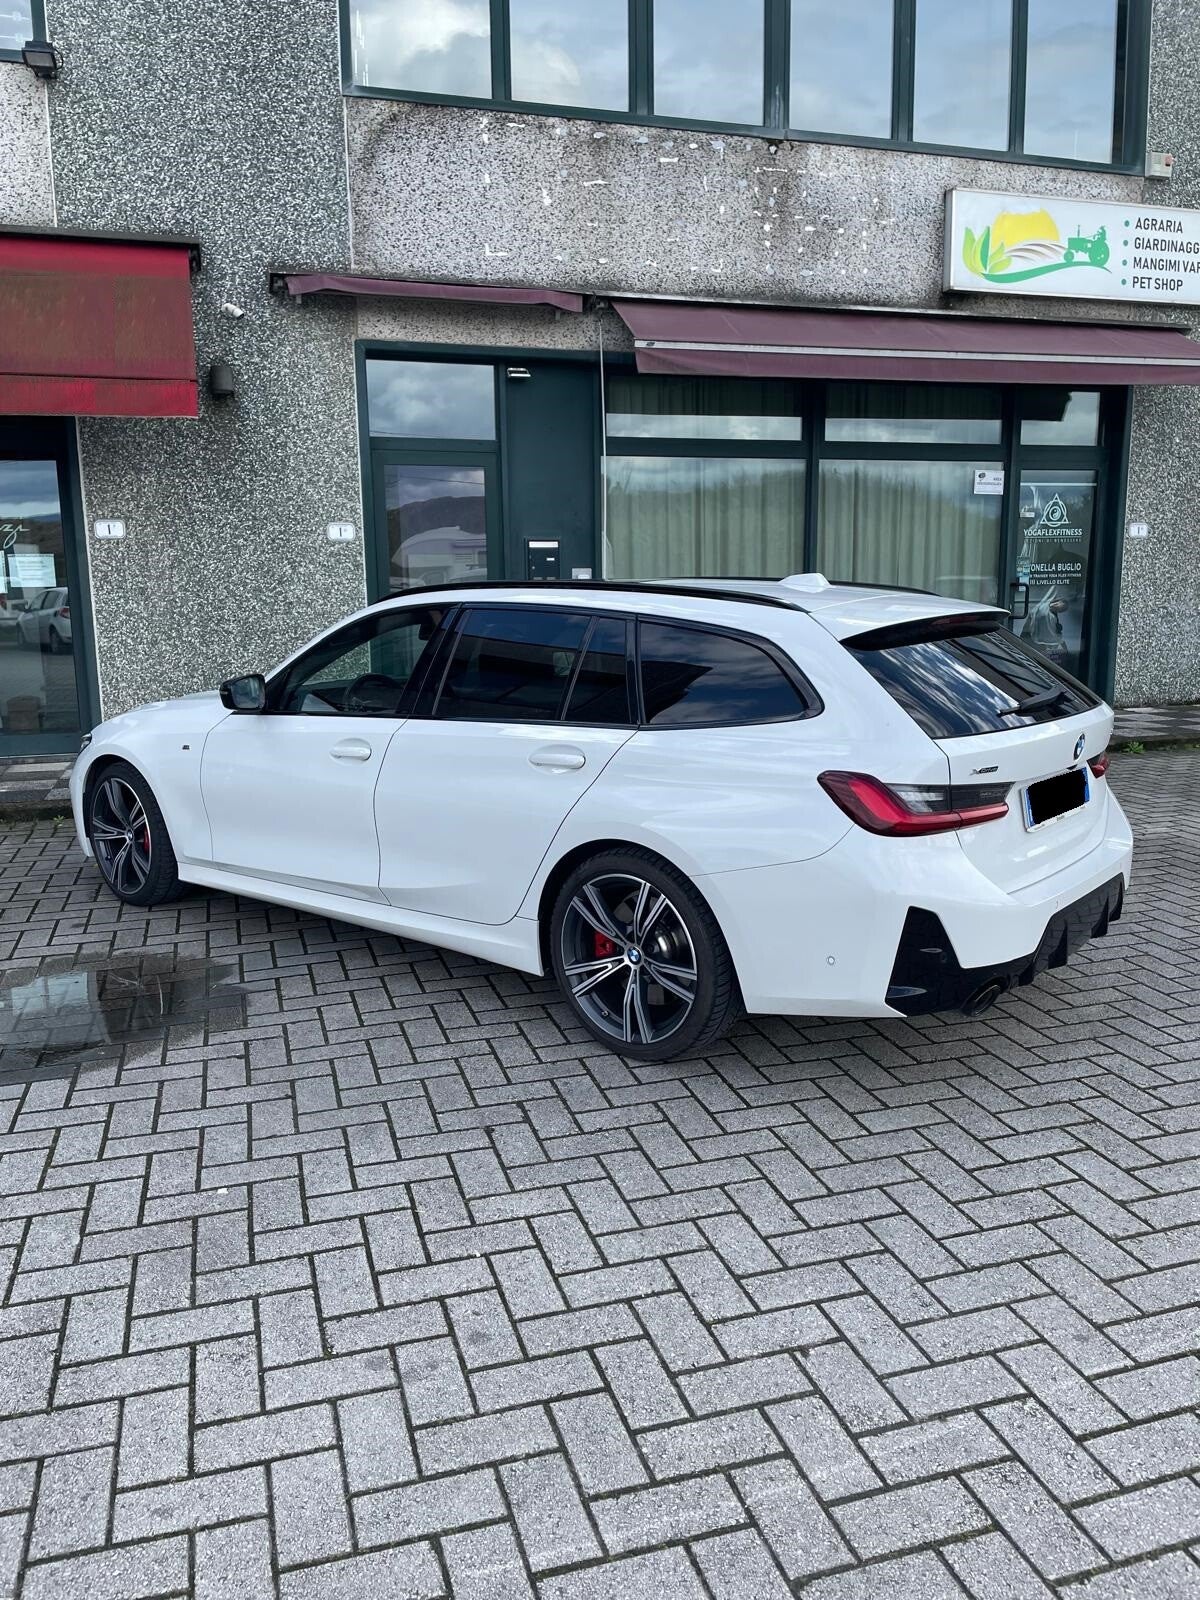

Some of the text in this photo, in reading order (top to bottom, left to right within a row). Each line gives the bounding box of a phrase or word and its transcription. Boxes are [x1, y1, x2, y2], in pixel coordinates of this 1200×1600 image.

[1135, 217, 1183, 233] AGRARIA
[1133, 256, 1180, 272] MANGIMI
[1132, 275, 1183, 291] PET SHOP
[1023, 528, 1083, 536] YOGAFLEXFITNESS
[1029, 563, 1056, 572] ONELLA
[1057, 562, 1082, 571] BUGLIO
